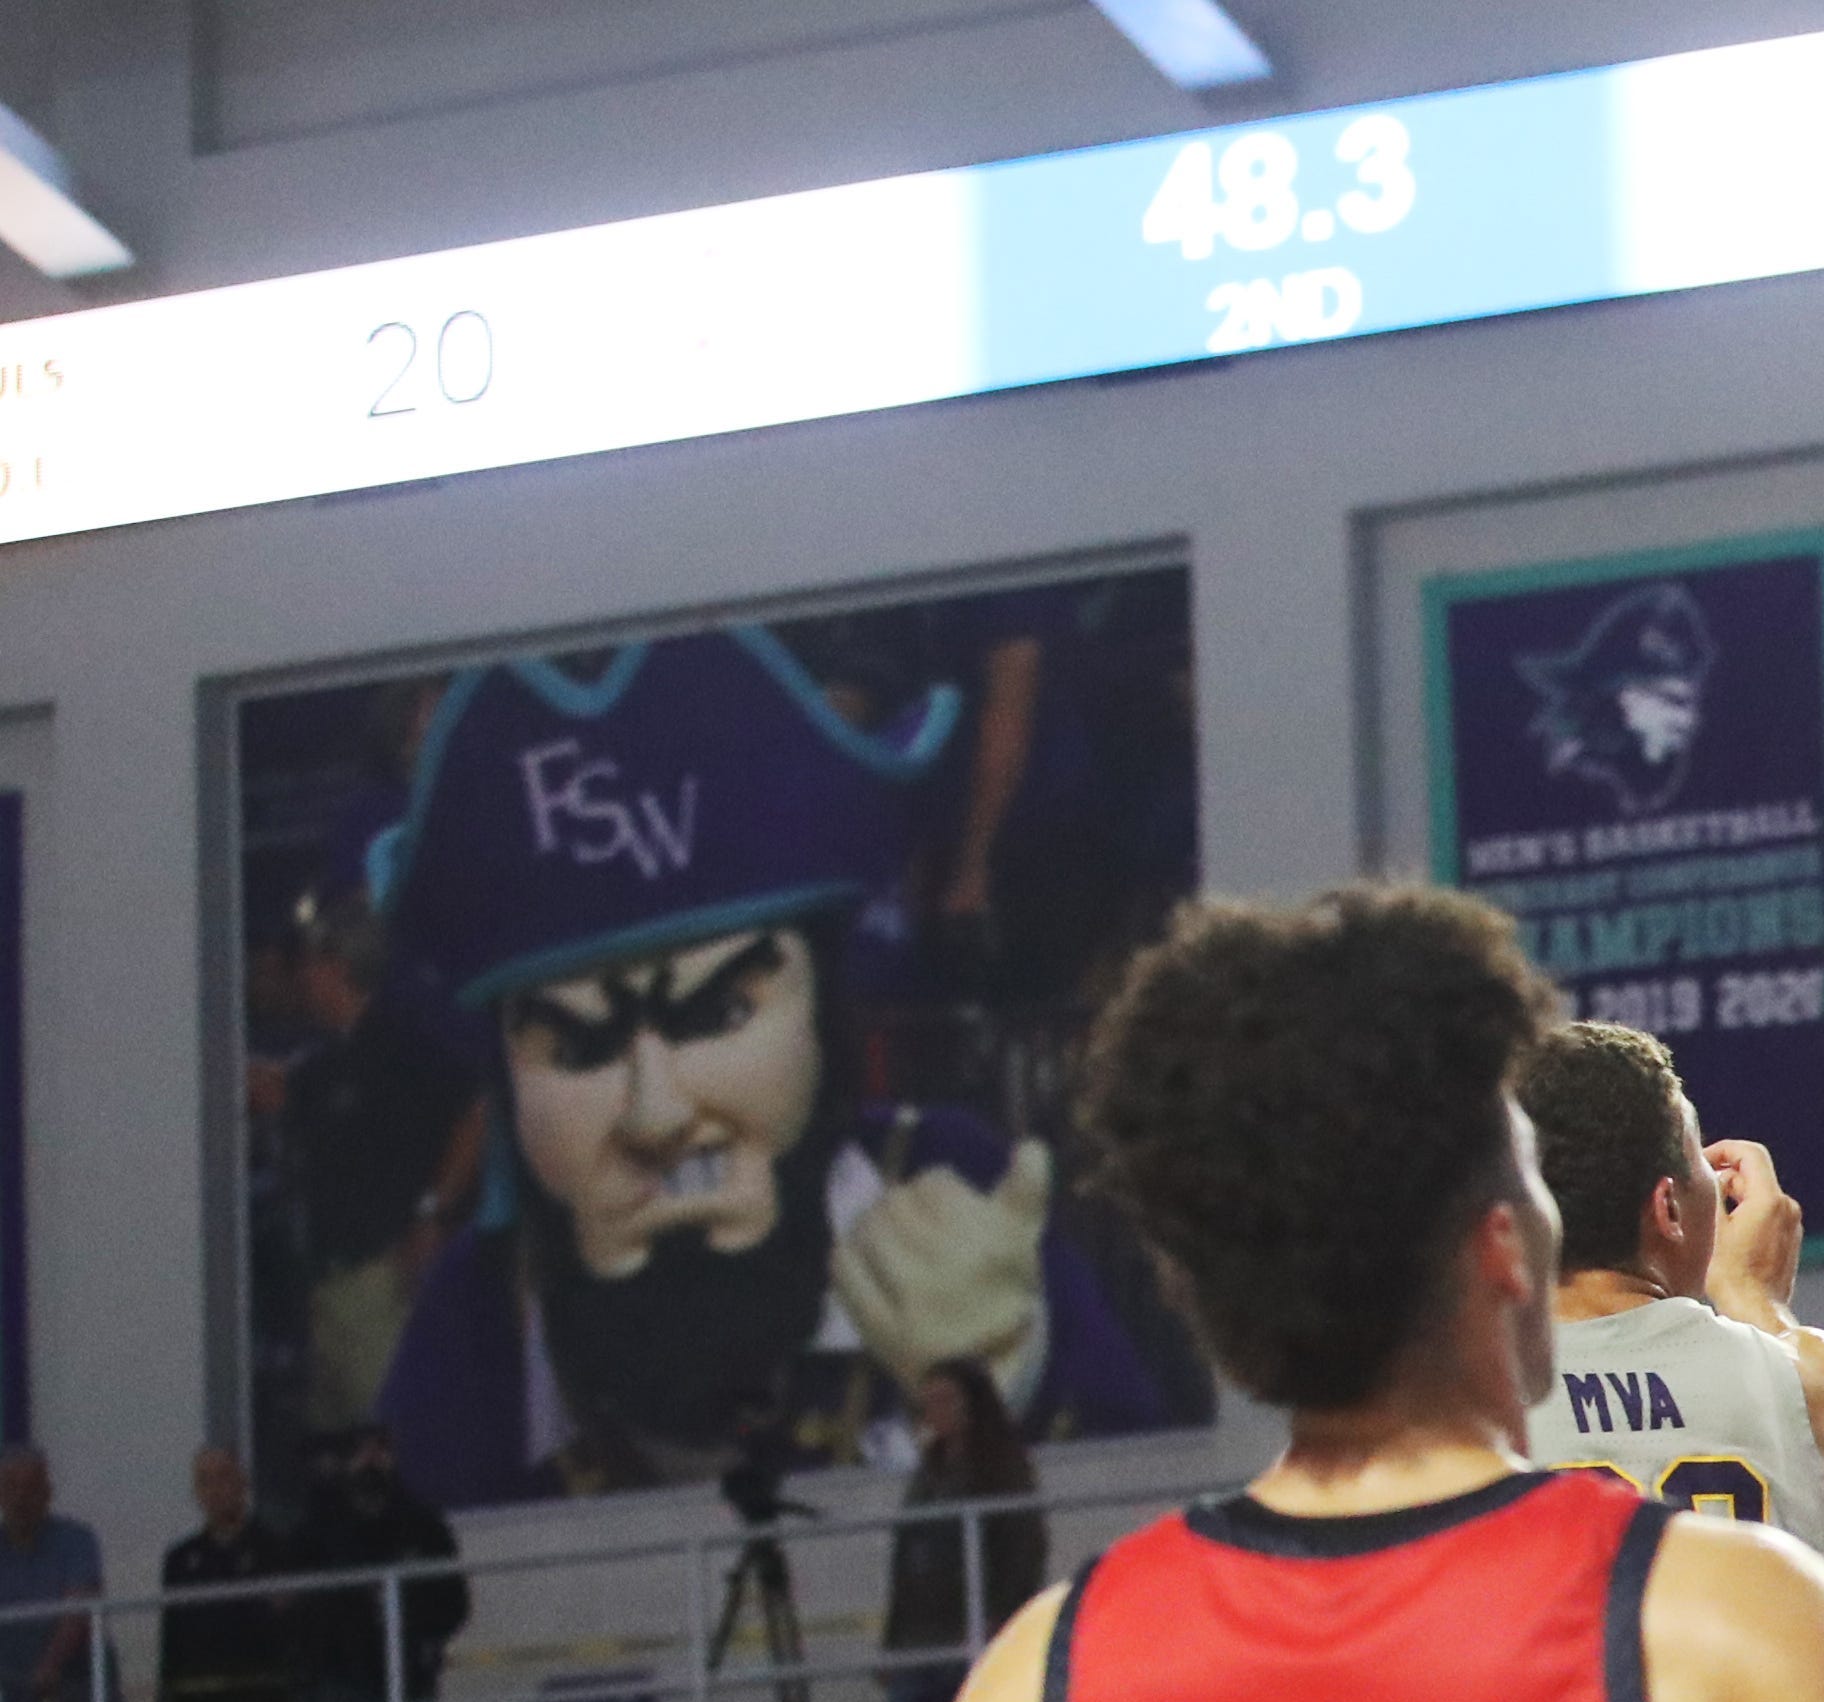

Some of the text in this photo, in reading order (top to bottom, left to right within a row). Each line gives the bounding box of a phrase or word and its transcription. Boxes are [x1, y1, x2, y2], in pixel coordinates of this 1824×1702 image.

[1142, 113, 1416, 260] 48.3
[1205, 266, 1363, 353] 2ND
[366, 310, 493, 417] 20
[518, 738, 701, 880] FSW
[1583, 800, 1821, 861] BASKETBALL
[1562, 1371, 1686, 1434] MVA
